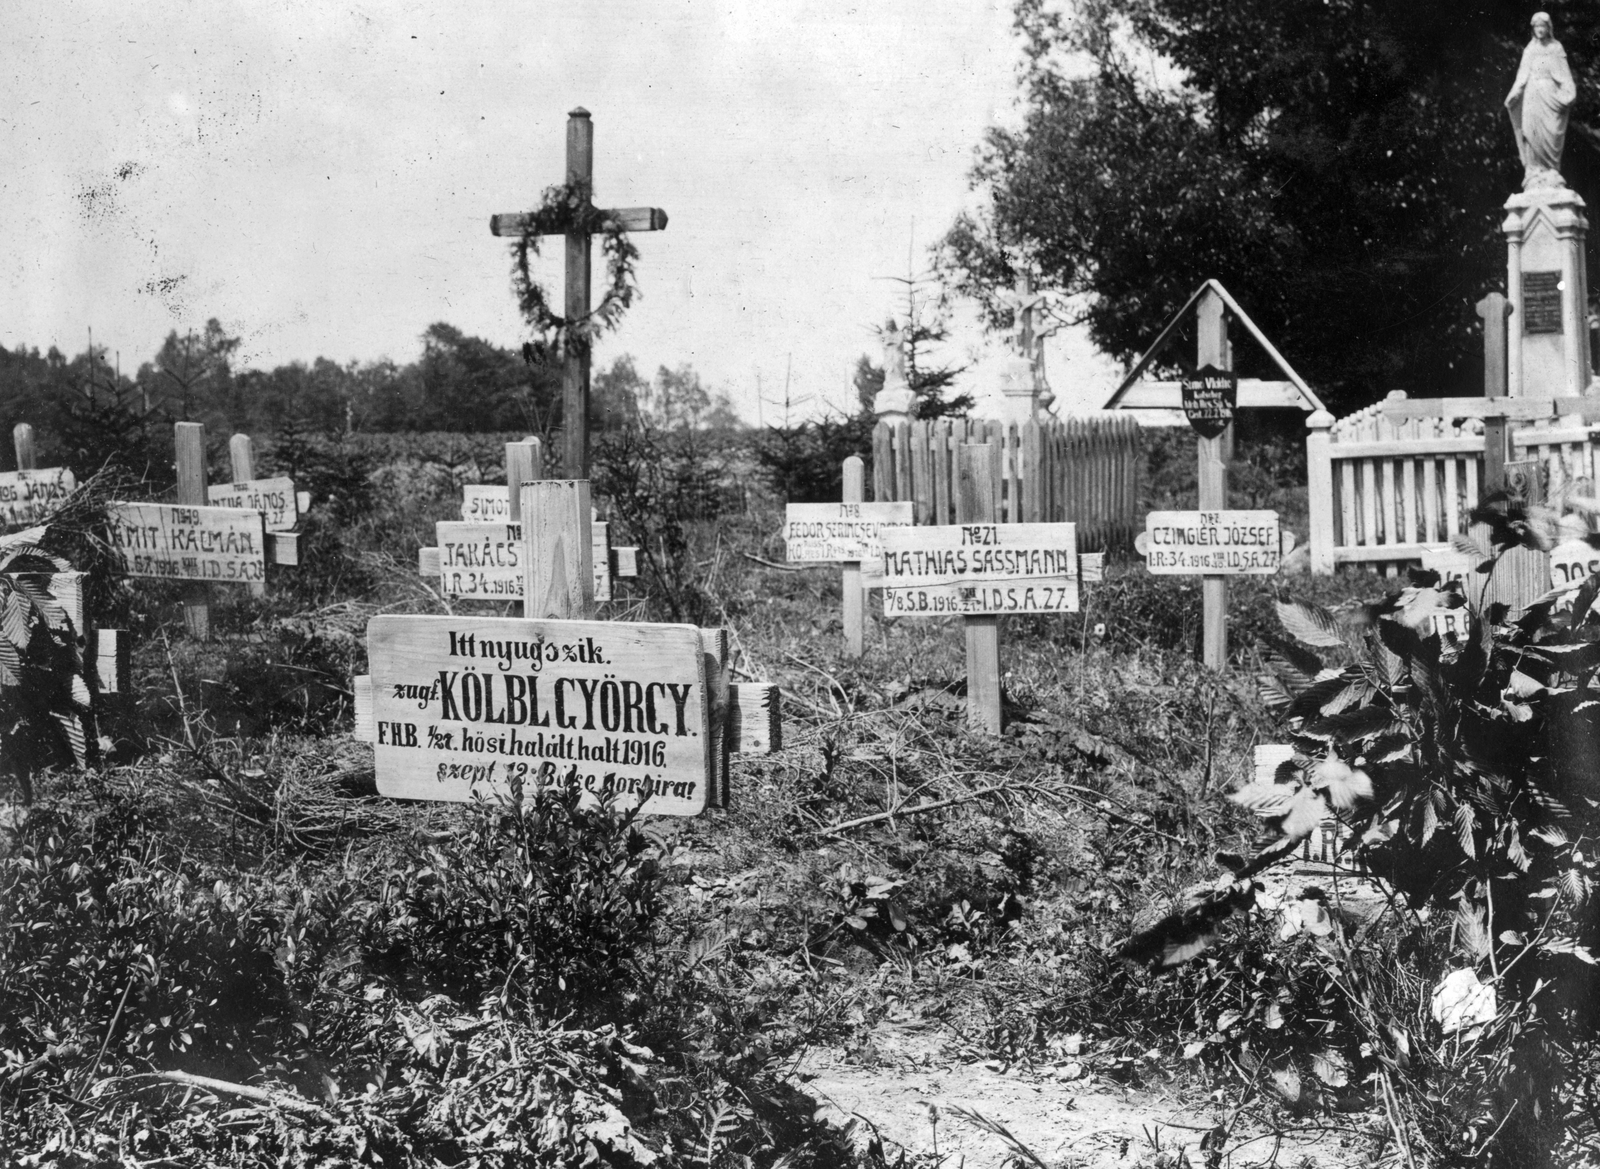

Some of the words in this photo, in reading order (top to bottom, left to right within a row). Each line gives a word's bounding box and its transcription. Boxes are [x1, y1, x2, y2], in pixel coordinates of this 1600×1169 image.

[884, 550, 967, 576] MATHIAS
[449, 631, 476, 658] Itt
[438, 666, 550, 728] KÖLBL
